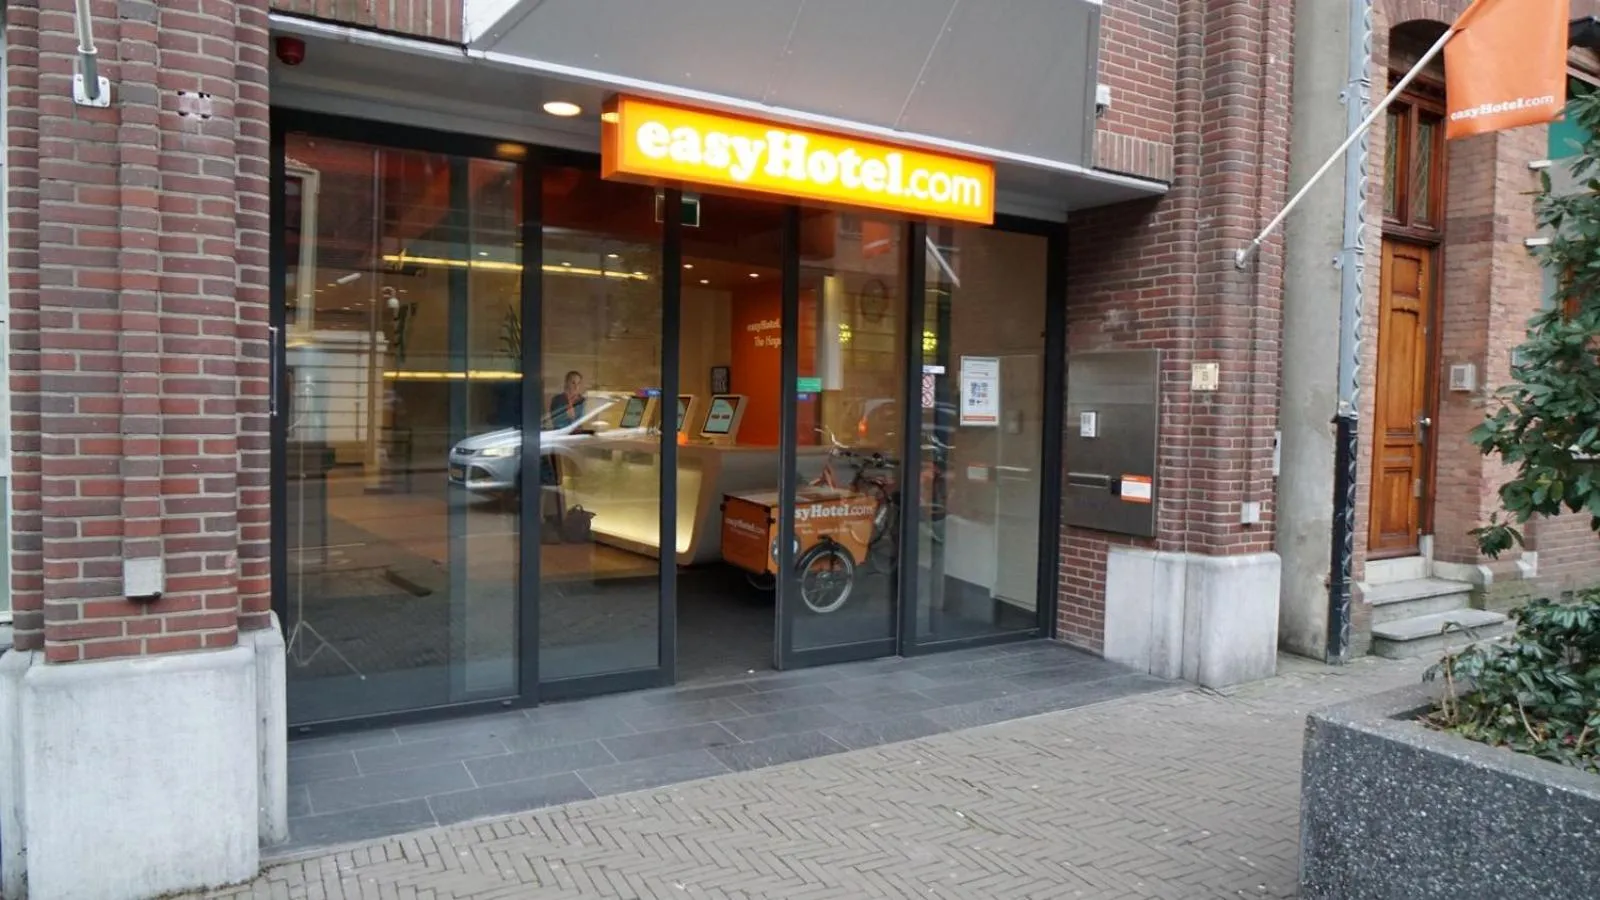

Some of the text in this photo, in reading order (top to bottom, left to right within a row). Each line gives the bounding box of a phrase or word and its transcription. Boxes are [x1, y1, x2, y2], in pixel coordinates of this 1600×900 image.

[1451, 95, 1554, 121] easyHotel.com
[636, 120, 982, 208] easyHotel.com
[794, 503, 874, 520] syHotel.com
